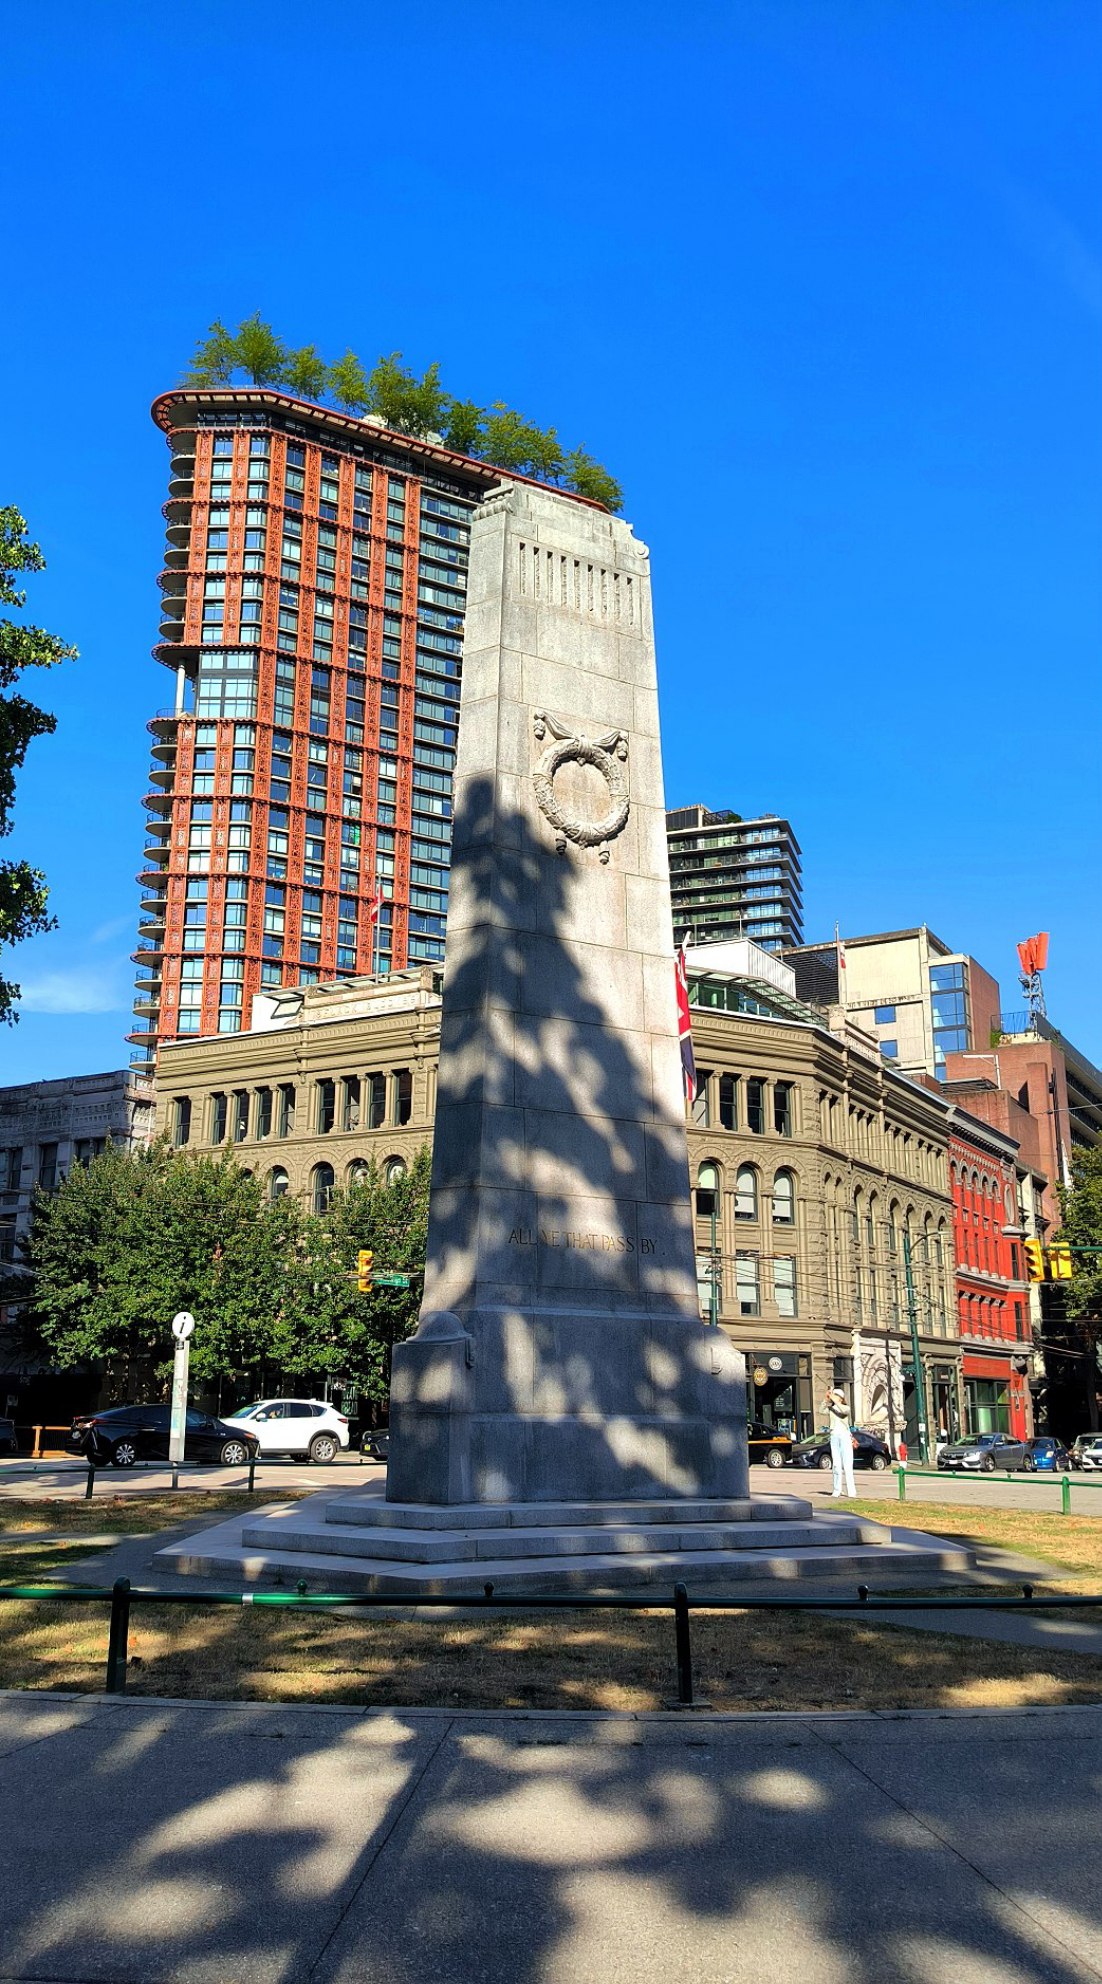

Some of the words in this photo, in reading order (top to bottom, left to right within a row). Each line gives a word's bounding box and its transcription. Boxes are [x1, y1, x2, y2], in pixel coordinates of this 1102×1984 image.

[508, 1228, 538, 1246] ALL
[562, 1231, 598, 1250] THAT
[602, 1234, 634, 1253] PASS
